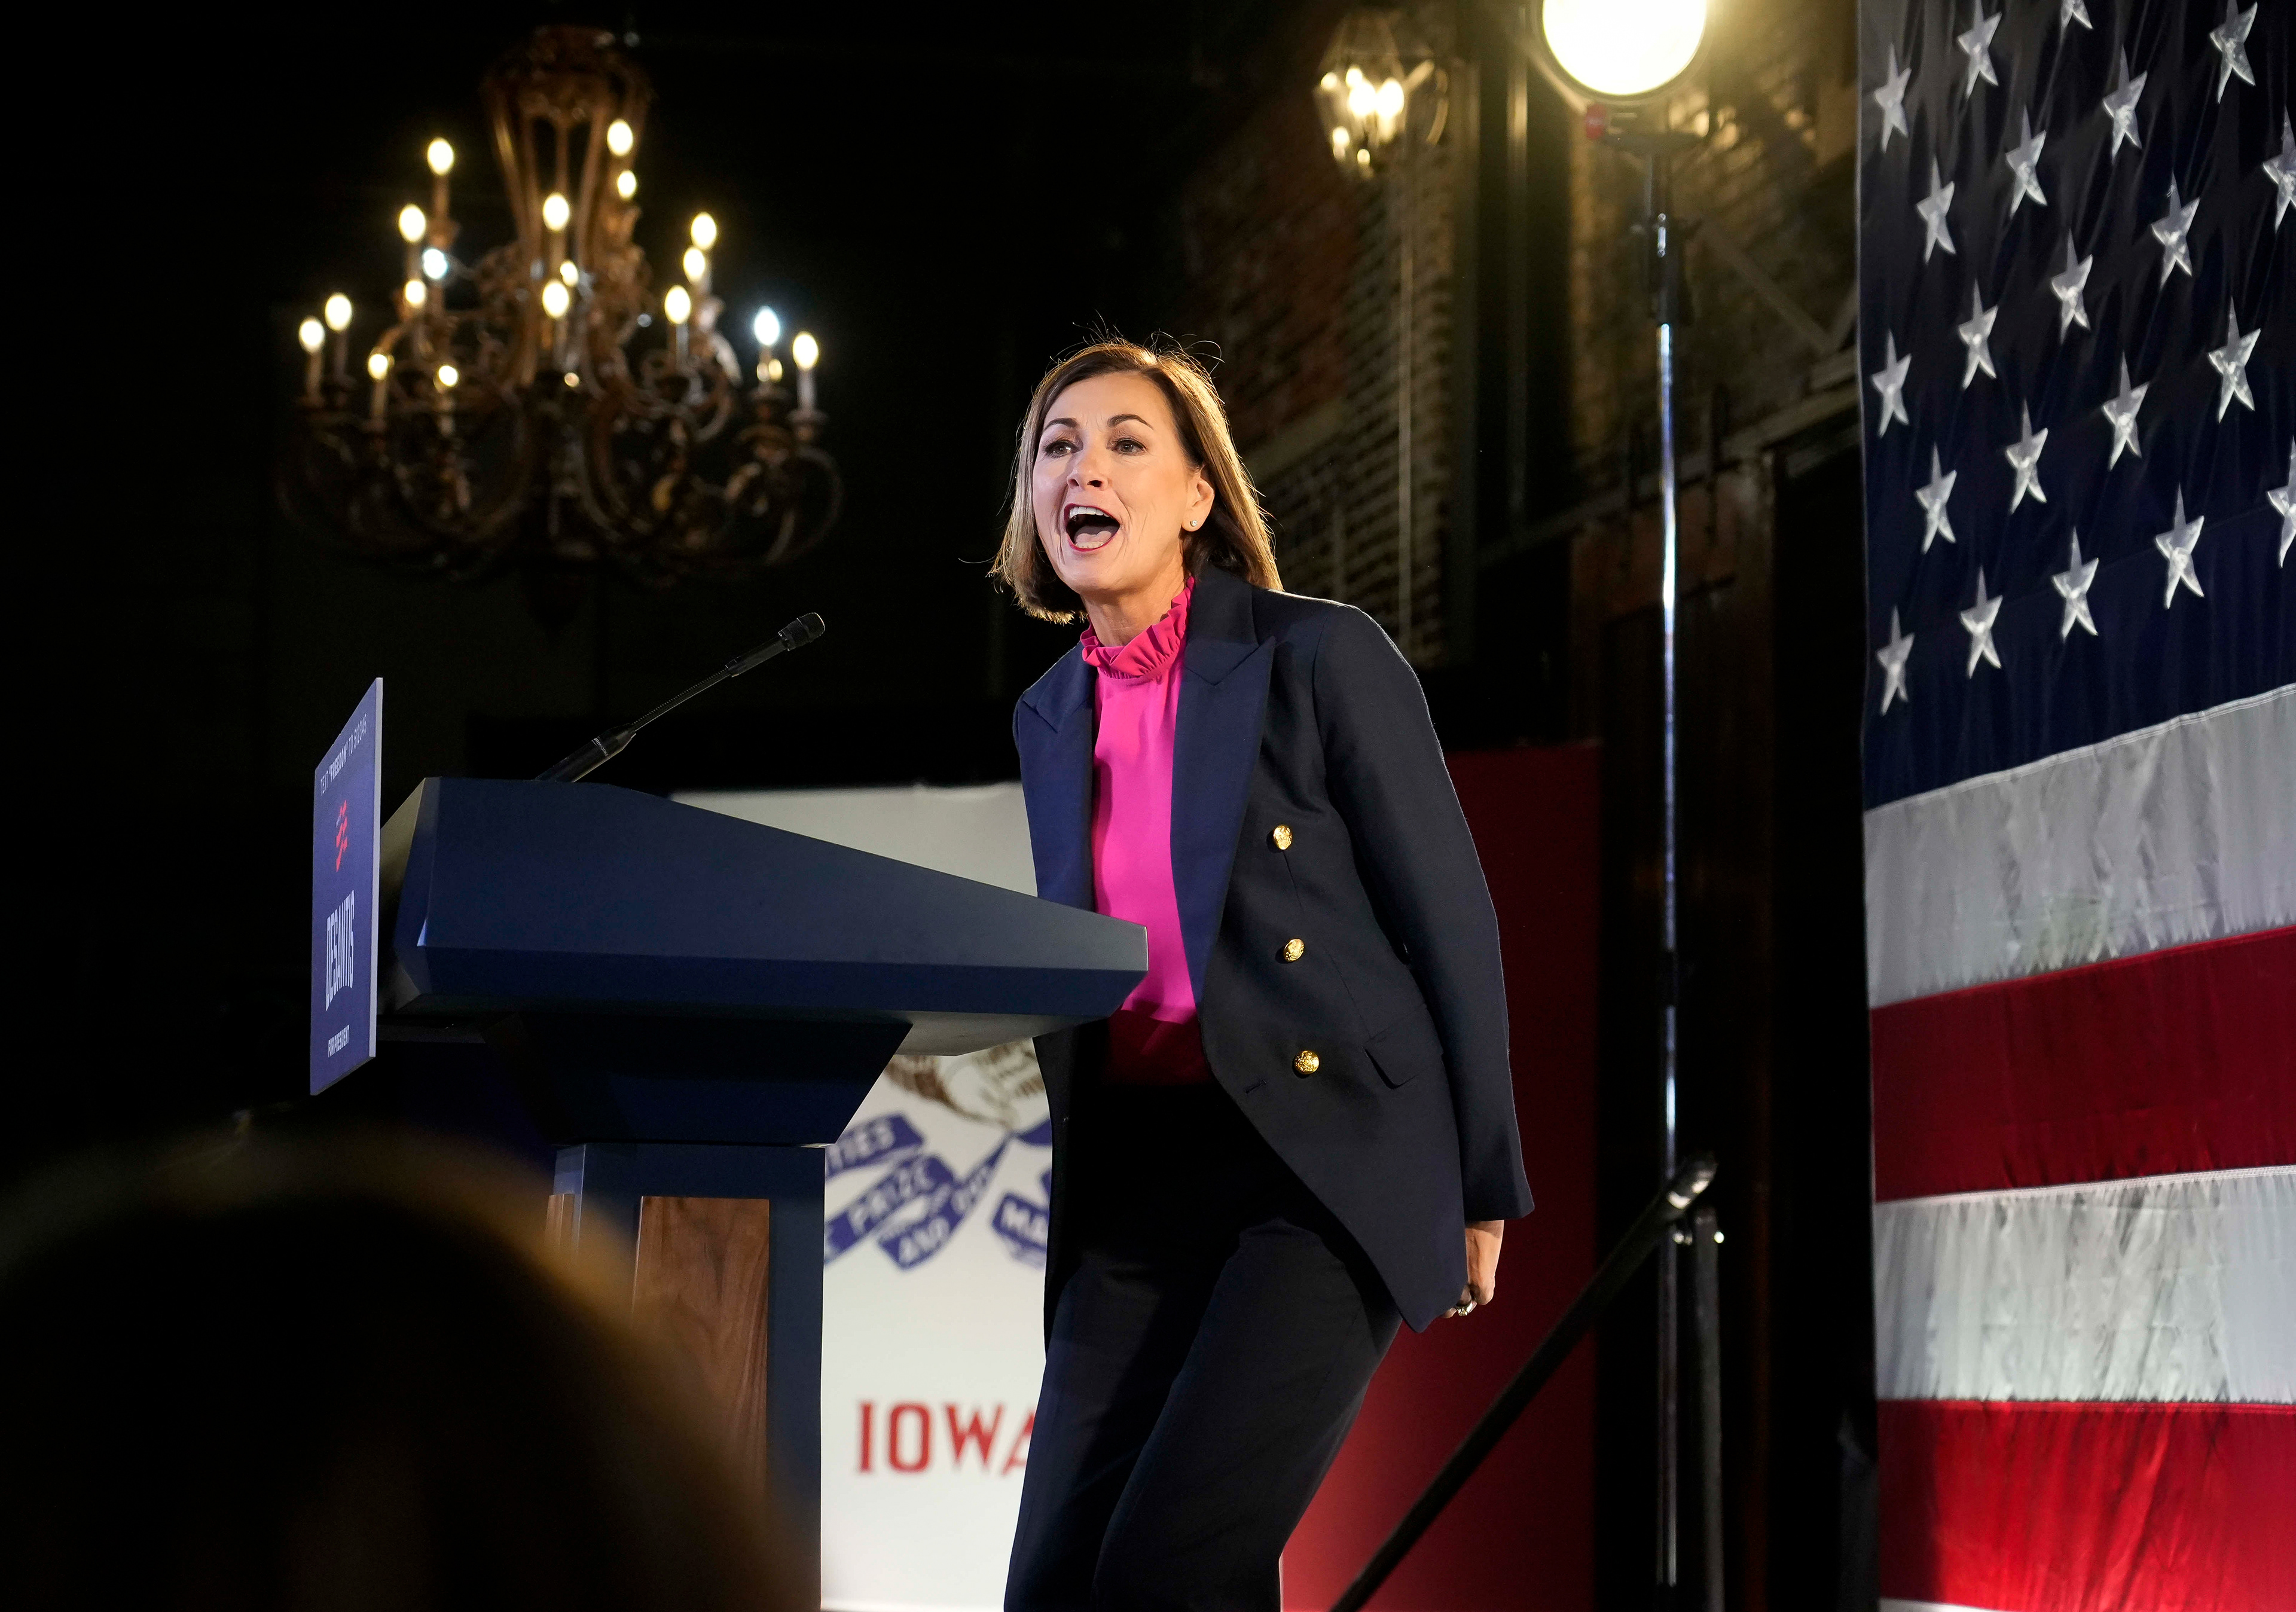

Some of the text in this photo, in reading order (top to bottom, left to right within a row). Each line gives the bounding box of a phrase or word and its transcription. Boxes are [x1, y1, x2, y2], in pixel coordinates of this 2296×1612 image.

[325, 889, 355, 1012] DESANTIS
[898, 1215, 951, 1263] AND
[1000, 1199, 1048, 1244] MA
[856, 1400, 1036, 1476] IOWA
